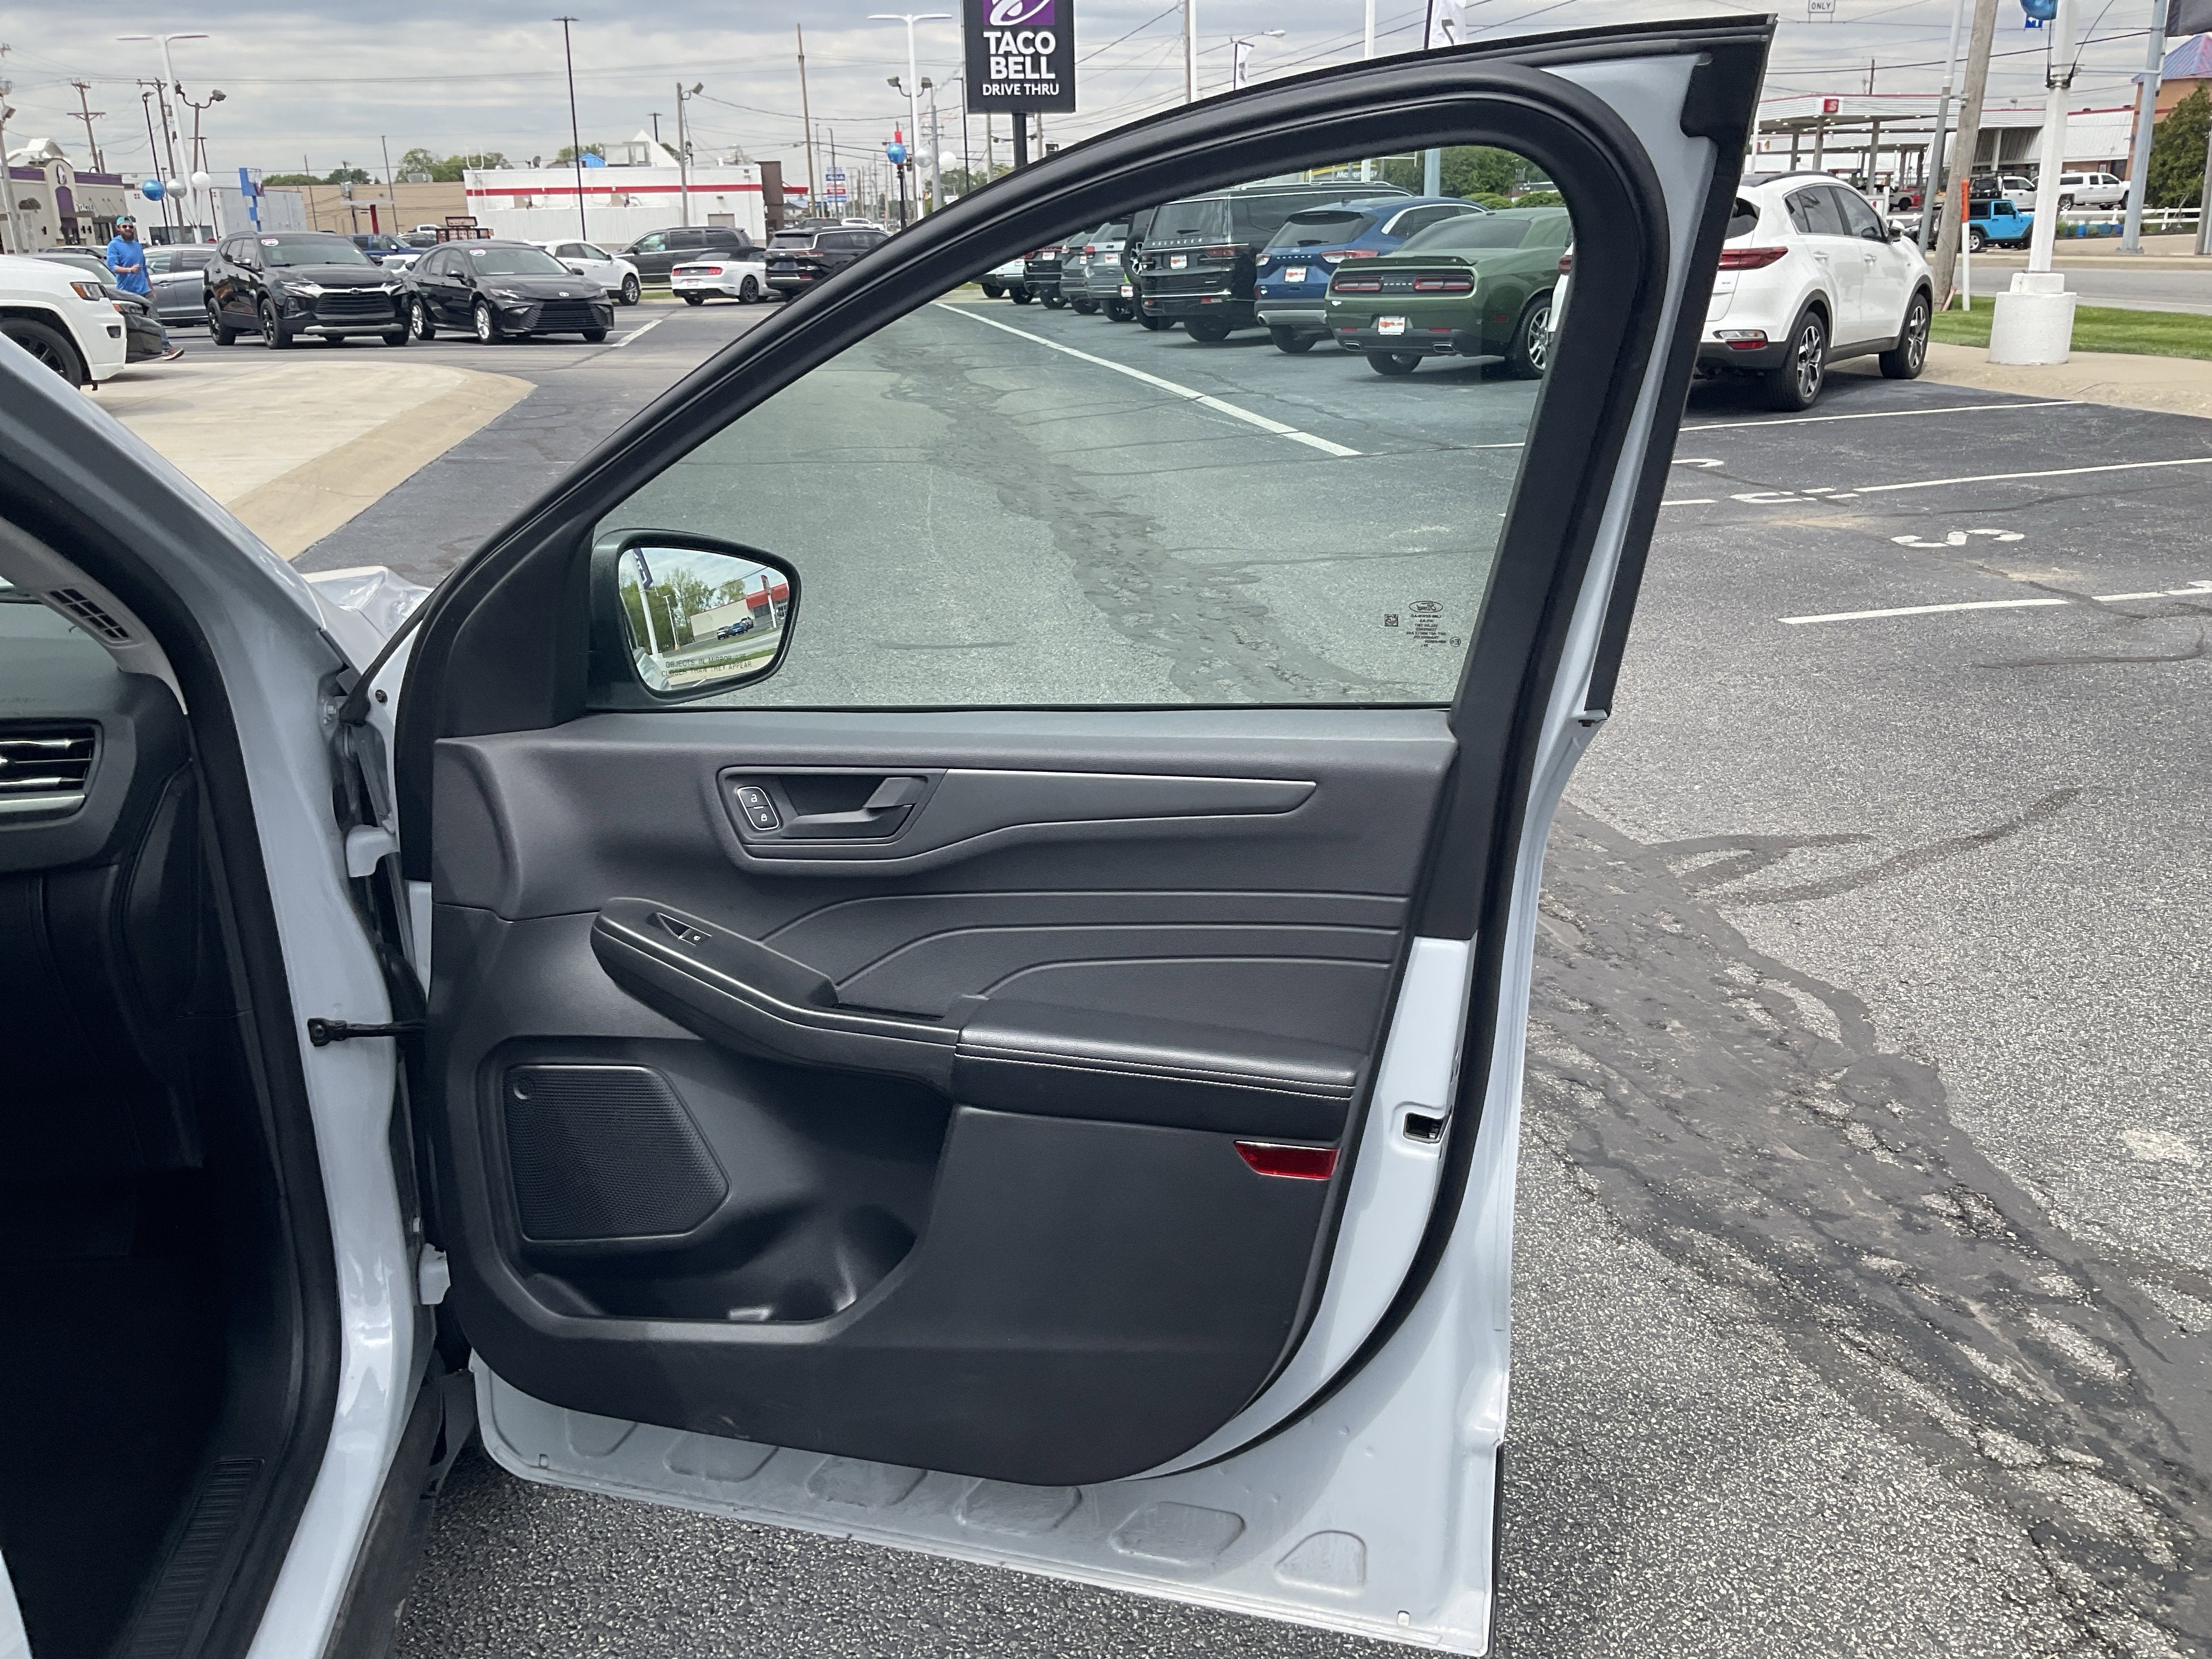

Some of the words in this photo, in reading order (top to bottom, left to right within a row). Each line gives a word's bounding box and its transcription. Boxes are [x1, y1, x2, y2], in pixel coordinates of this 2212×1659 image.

[983, 31, 1056, 55] TACO
[990, 57, 1056, 80] BELL
[983, 84, 1021, 96] DRIVE
[1024, 83, 1059, 96] THRU
[665, 659, 695, 668] OBJECTS
[729, 661, 752, 670] APPEAR
